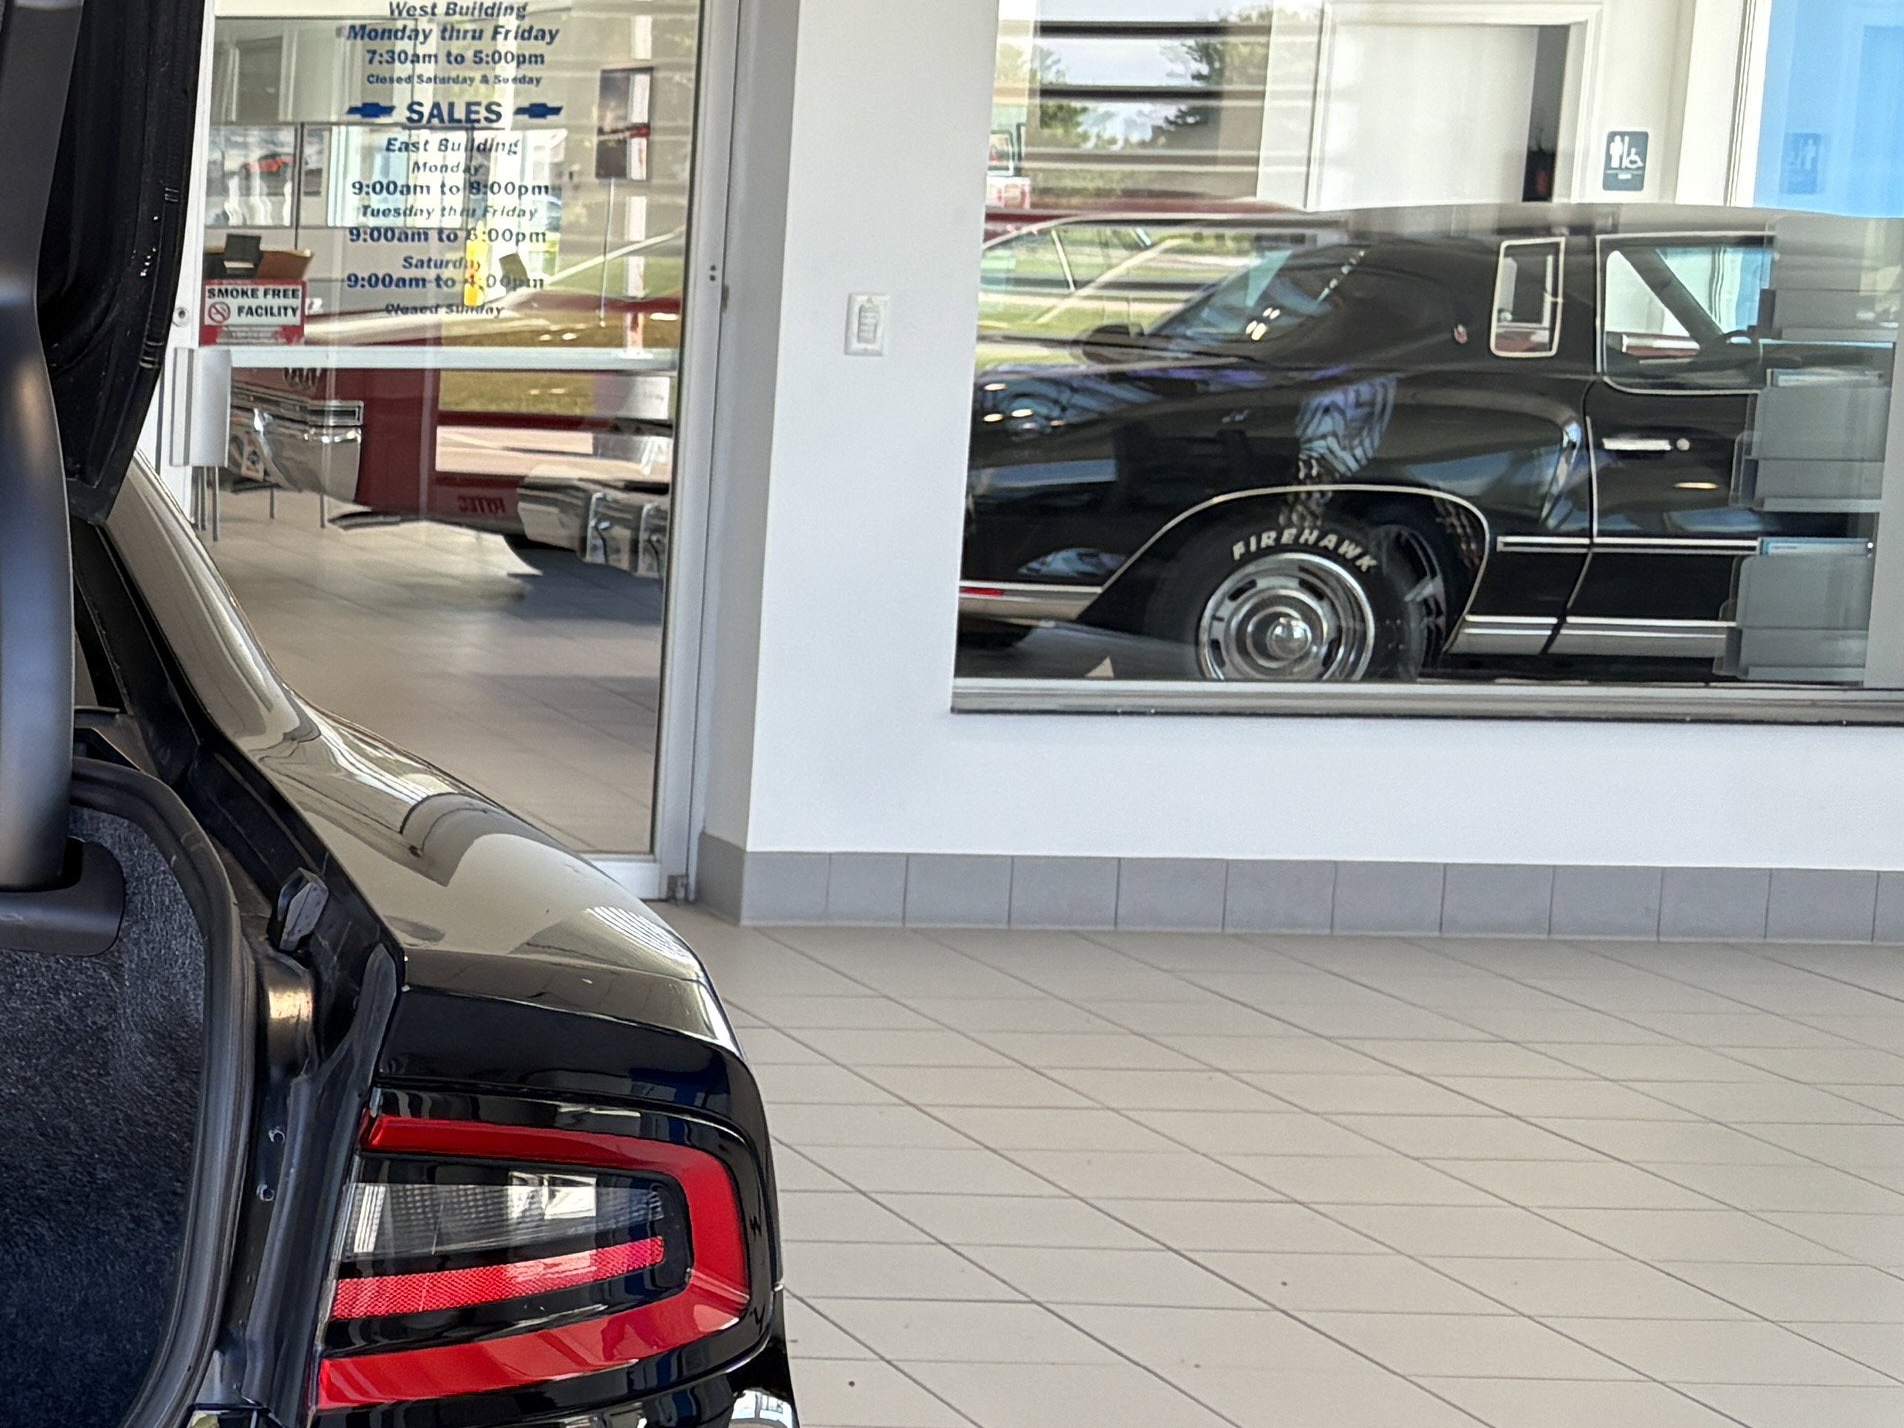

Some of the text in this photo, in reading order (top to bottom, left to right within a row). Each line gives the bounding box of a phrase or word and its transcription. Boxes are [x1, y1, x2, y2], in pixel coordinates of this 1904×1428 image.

[389, 1, 527, 20] West Building
[346, 25, 559, 45] Monday thru Friday
[366, 49, 545, 68] 7:30am to 5:00pm
[367, 74, 412, 85] Closed
[417, 74, 475, 87] Saturday
[494, 75, 542, 87] Sunday
[406, 101, 502, 124] SALES
[385, 137, 520, 156] East Building
[411, 162, 481, 176] Monday
[351, 180, 550, 199] 9:00am to 8:00pm
[361, 205, 538, 221] Tuesday thru Friday
[349, 227, 429, 243] 9:00am
[438, 227, 458, 243] to
[402, 256, 480, 271] Saturday
[346, 273, 427, 289] 9:00am
[435, 274, 456, 289] to
[207, 288, 300, 299] SMOKE FREE
[237, 306, 299, 317] FACILITY
[445, 304, 504, 318] Sunday
[1232, 528, 1377, 572] FIREHAWK
